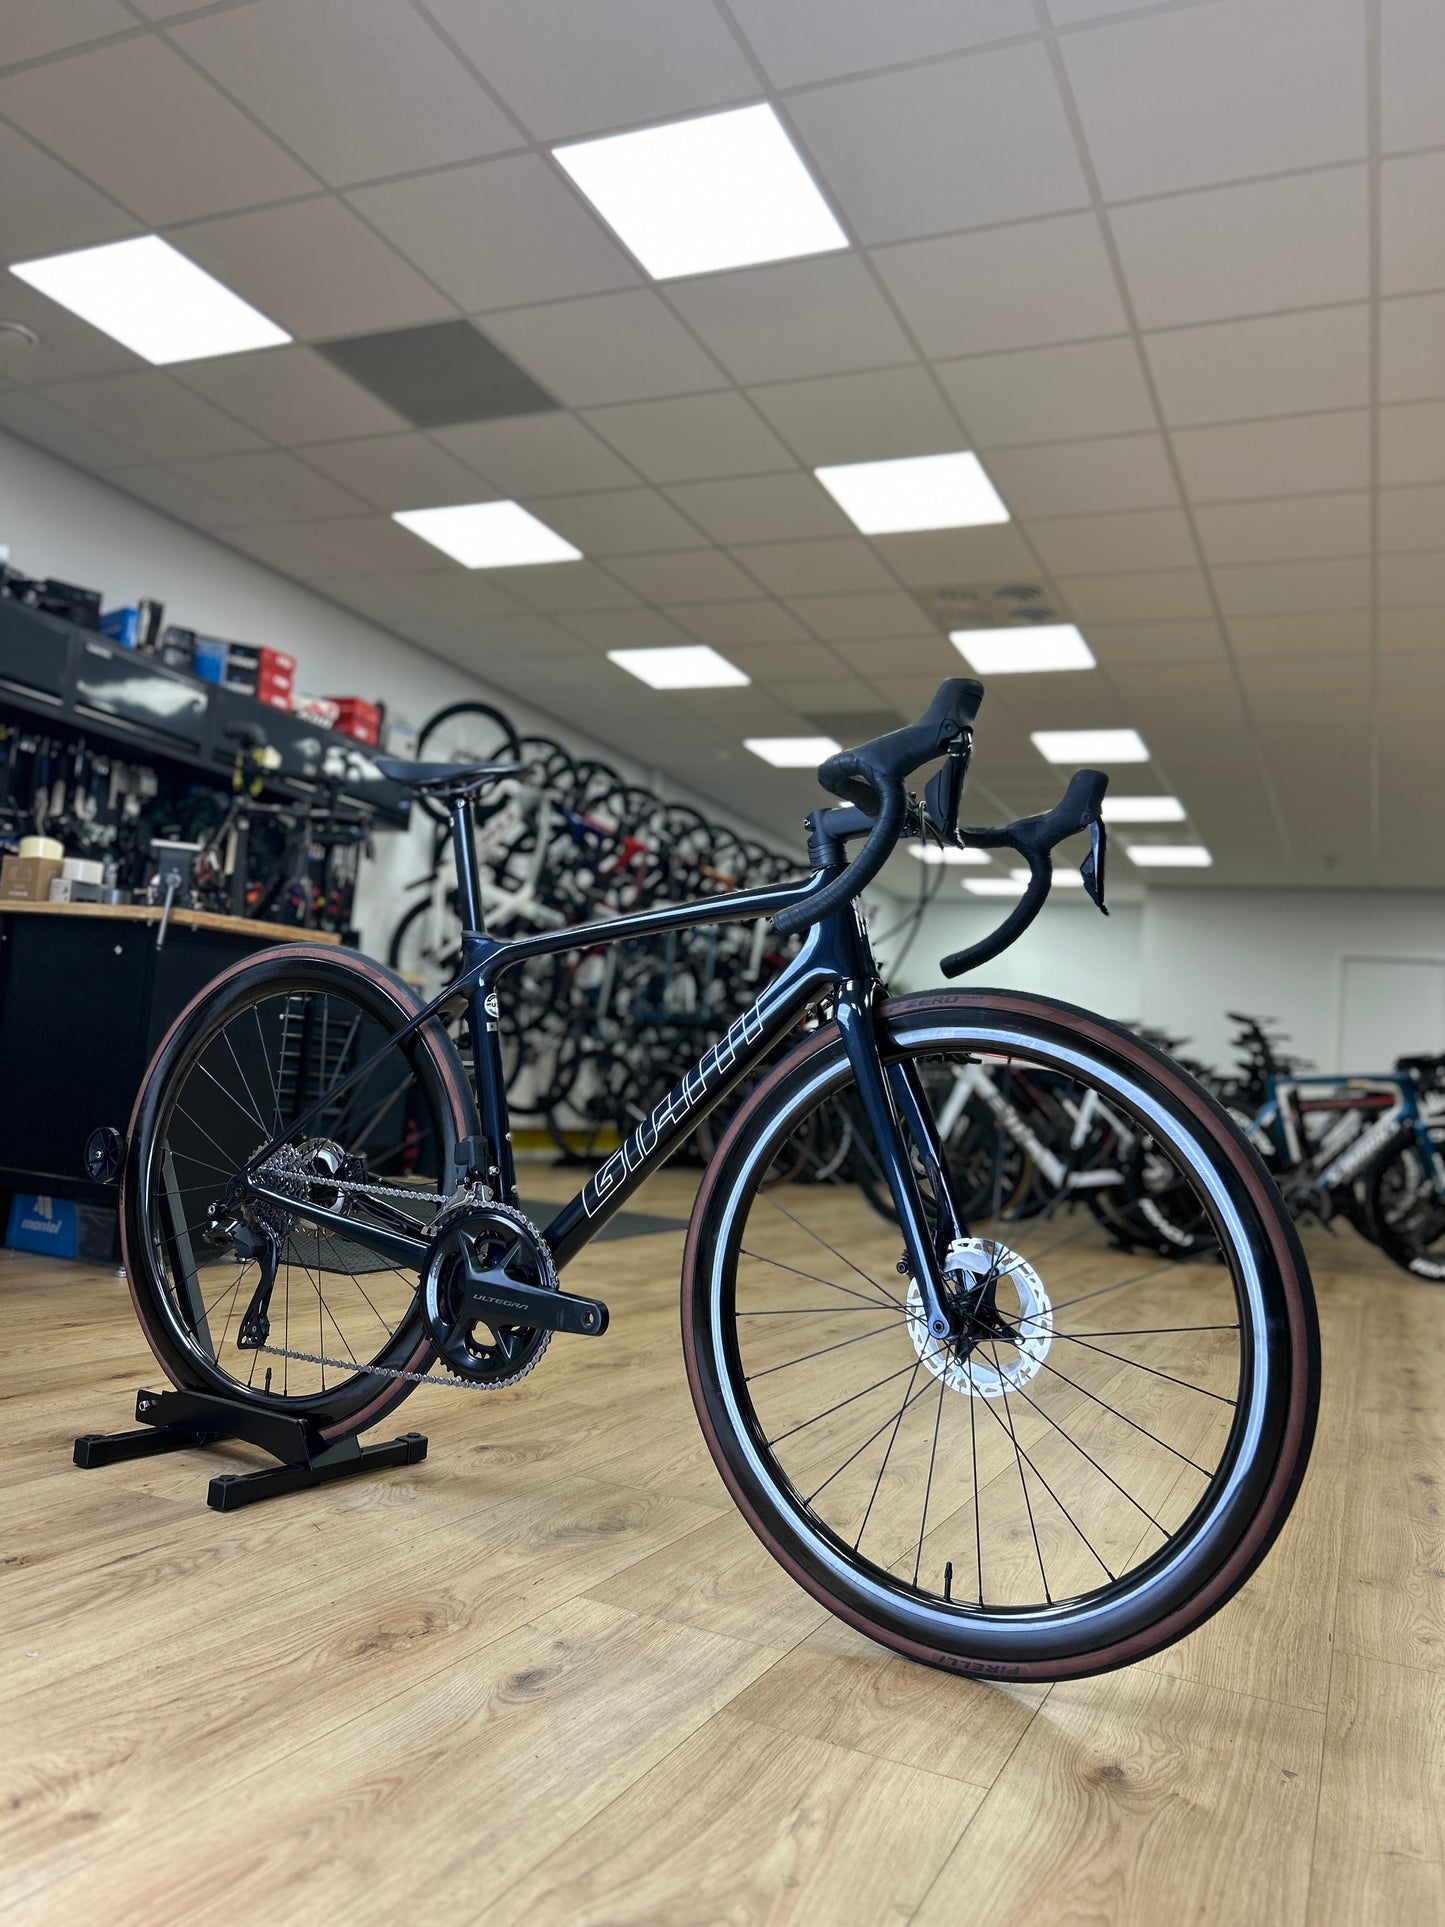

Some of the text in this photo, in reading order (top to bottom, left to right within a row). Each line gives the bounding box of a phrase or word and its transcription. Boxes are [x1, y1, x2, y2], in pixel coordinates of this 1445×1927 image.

[905, 995, 960, 1008] ZERO
[582, 985, 770, 1219] GIANT
[473, 1294, 529, 1310] ULTEGRA
[939, 1655, 1020, 1674] PIRELLI
